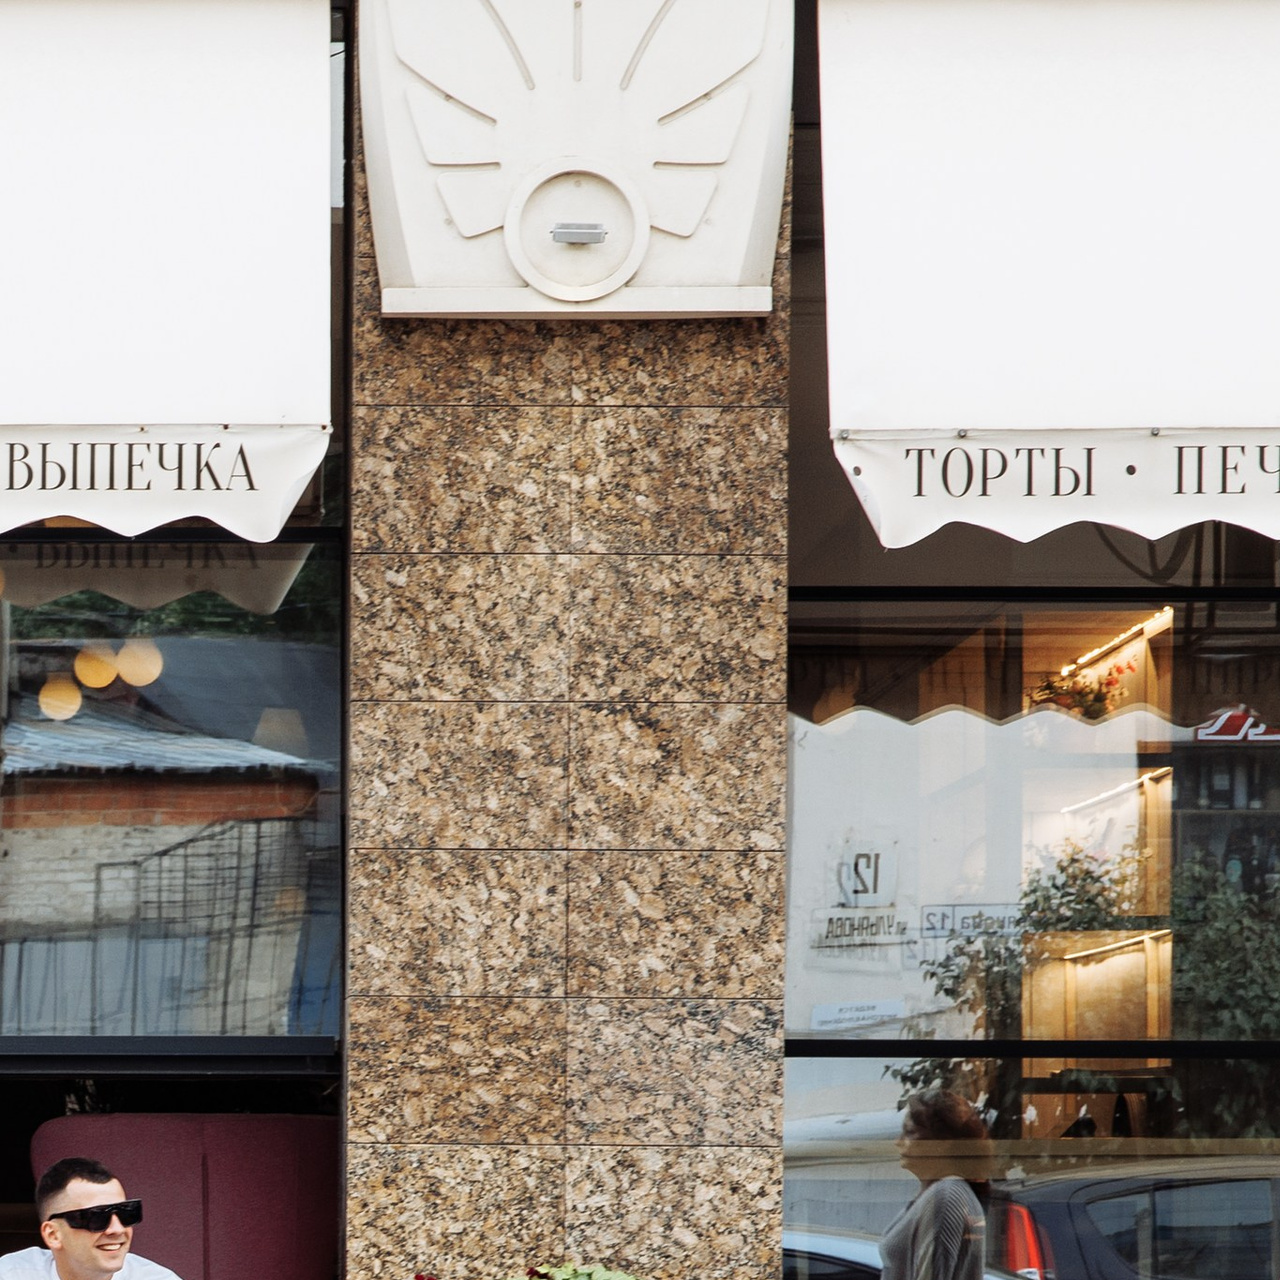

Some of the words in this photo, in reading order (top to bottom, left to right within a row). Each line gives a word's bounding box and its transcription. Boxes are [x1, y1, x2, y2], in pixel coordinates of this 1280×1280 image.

[5, 442, 258, 491] ВЫПЕЧКА
[905, 447, 1096, 497] ТОРТЫ
[1173, 445, 1280, 495] ПЕЧ
